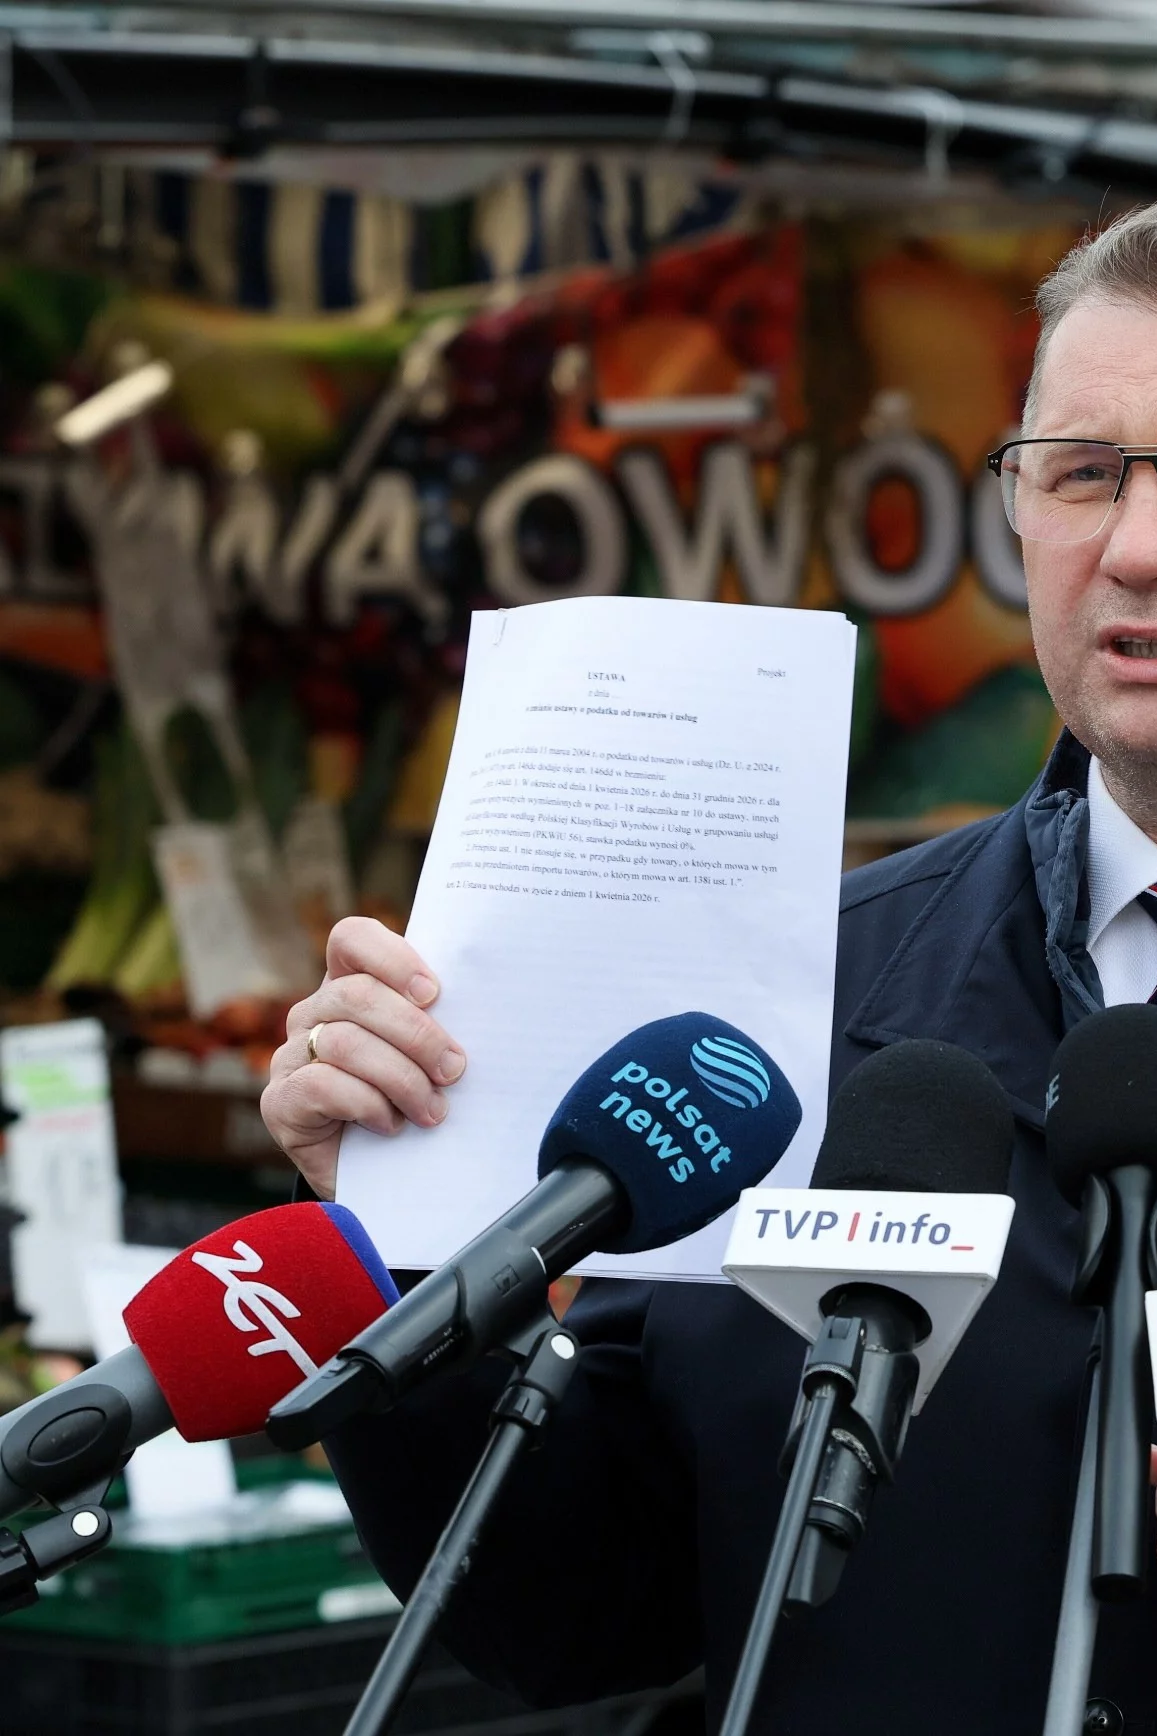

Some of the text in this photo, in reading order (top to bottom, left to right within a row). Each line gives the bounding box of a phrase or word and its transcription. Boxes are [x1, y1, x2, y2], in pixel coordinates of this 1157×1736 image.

[587, 670, 625, 682] USTAWA
[757, 667, 786, 679] Projekt
[594, 689, 610, 698] dnia
[554, 705, 577, 715] ustawy
[586, 706, 618, 716] podatku
[621, 709, 630, 717] od
[633, 710, 667, 719] towarów
[675, 712, 698, 723] usług
[538, 763, 561, 774] dodaje
[575, 766, 586, 774] art.
[590, 767, 614, 777] 146dd
[549, 747, 570, 755] marca
[572, 748, 590, 756] 2004
[606, 751, 637, 762] podatku
[639, 754, 649, 762] od
[651, 755, 684, 766] towarów
[692, 758, 713, 769] usług
[715, 760, 732, 769] (Dz.
[734, 761, 744, 770] U.
[753, 763, 773, 772] 2024
[775, 765, 781, 773] r.
[530, 780, 556, 789] okresie
[558, 782, 567, 790] od
[569, 782, 586, 791] dnia
[595, 784, 628, 795] kwietnia
[631, 787, 650, 797] 2026
[660, 789, 670, 798] do
[672, 791, 690, 800] dnia
[691, 792, 701, 801] 31
[704, 794, 735, 804] grudnia
[737, 795, 757, 805] 2026
[767, 798, 780, 806] dla
[527, 796, 582, 808] wymienionych
[594, 802, 609, 811] poz.
[637, 805, 678, 817] załącznika
[693, 809, 703, 818] 10
[705, 809, 716, 819] do
[752, 813, 779, 824] innych
[510, 812, 536, 823] według
[538, 813, 568, 825] Polskiej
[570, 816, 618, 830] Klasyfikacji
[620, 820, 659, 831] Wyrobów
[667, 824, 691, 836] Usług
[704, 827, 752, 840] grupowaniu
[754, 830, 779, 841] usługi
[532, 829, 566, 841] (PKWiU
[585, 834, 613, 845] stawka
[615, 836, 647, 848] podatku
[649, 839, 678, 851] wynosi
[499, 844, 511, 853] ust.
[521, 846, 532, 855] nie
[535, 848, 561, 859] stosuje
[589, 852, 631, 865] przypadku
[633, 856, 648, 866] gdy
[651, 858, 681, 868] towary,
[691, 859, 722, 870] których
[724, 863, 749, 871] mowa
[761, 865, 777, 874] tym
[482, 861, 530, 872] przedmiotem
[532, 863, 563, 875] importu
[564, 867, 602, 878] towarów,
[611, 870, 639, 881] którym
[642, 873, 666, 882] mowa
[677, 875, 691, 883] art.
[694, 875, 711, 885] 138i
[713, 877, 727, 886] ust.
[488, 881, 520, 893] wchodzi
[531, 885, 553, 897] życie
[561, 887, 586, 898] dniem
[595, 890, 630, 902] kwietnia
[631, 893, 652, 903] 2026
[610, 1061, 732, 1174] polsat
[599, 1091, 695, 1183] news
[755, 1209, 839, 1240] TVP
[191, 1239, 319, 1378] ZET
